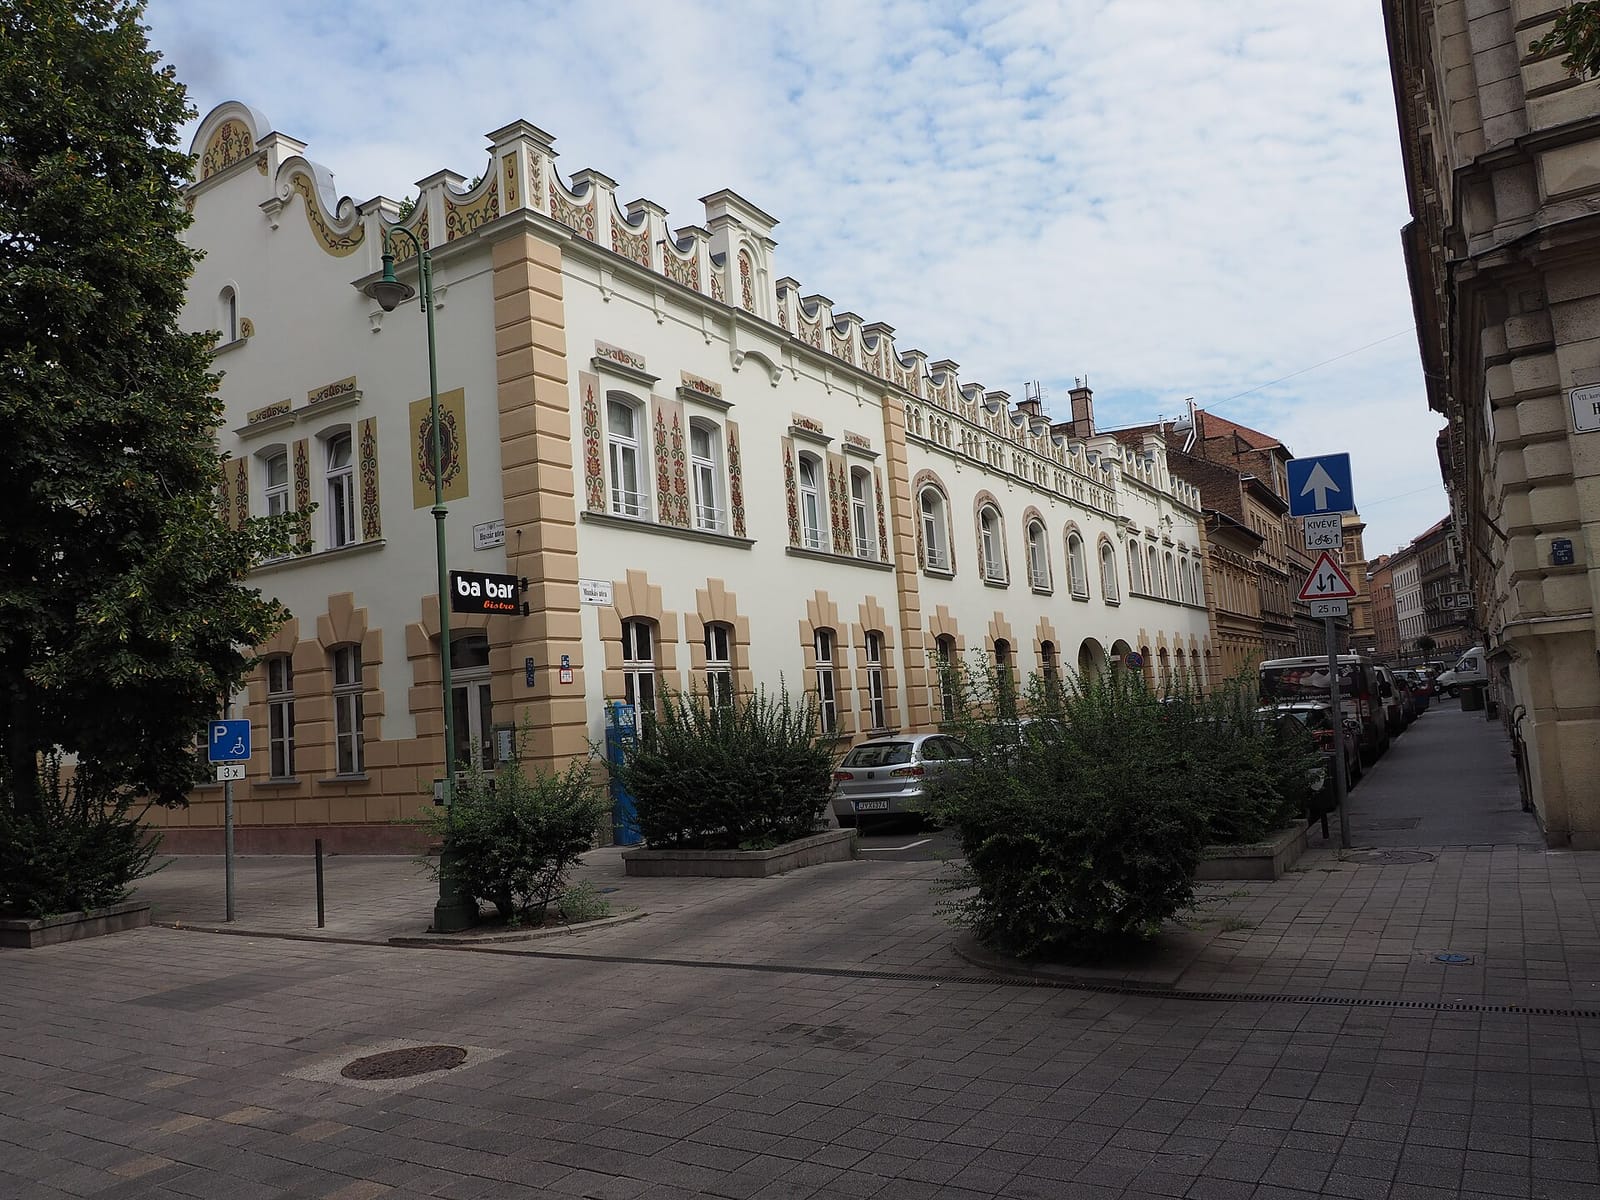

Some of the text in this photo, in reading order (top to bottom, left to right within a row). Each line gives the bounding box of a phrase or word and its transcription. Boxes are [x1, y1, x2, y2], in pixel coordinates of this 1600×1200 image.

[1307, 519, 1338, 529] KIVÉVE
[457, 576, 514, 599] ba bar
[483, 600, 515, 610] bistro
[1317, 604, 1329, 613] 25
[214, 725, 228, 744] P
[223, 767, 230, 778] 3
